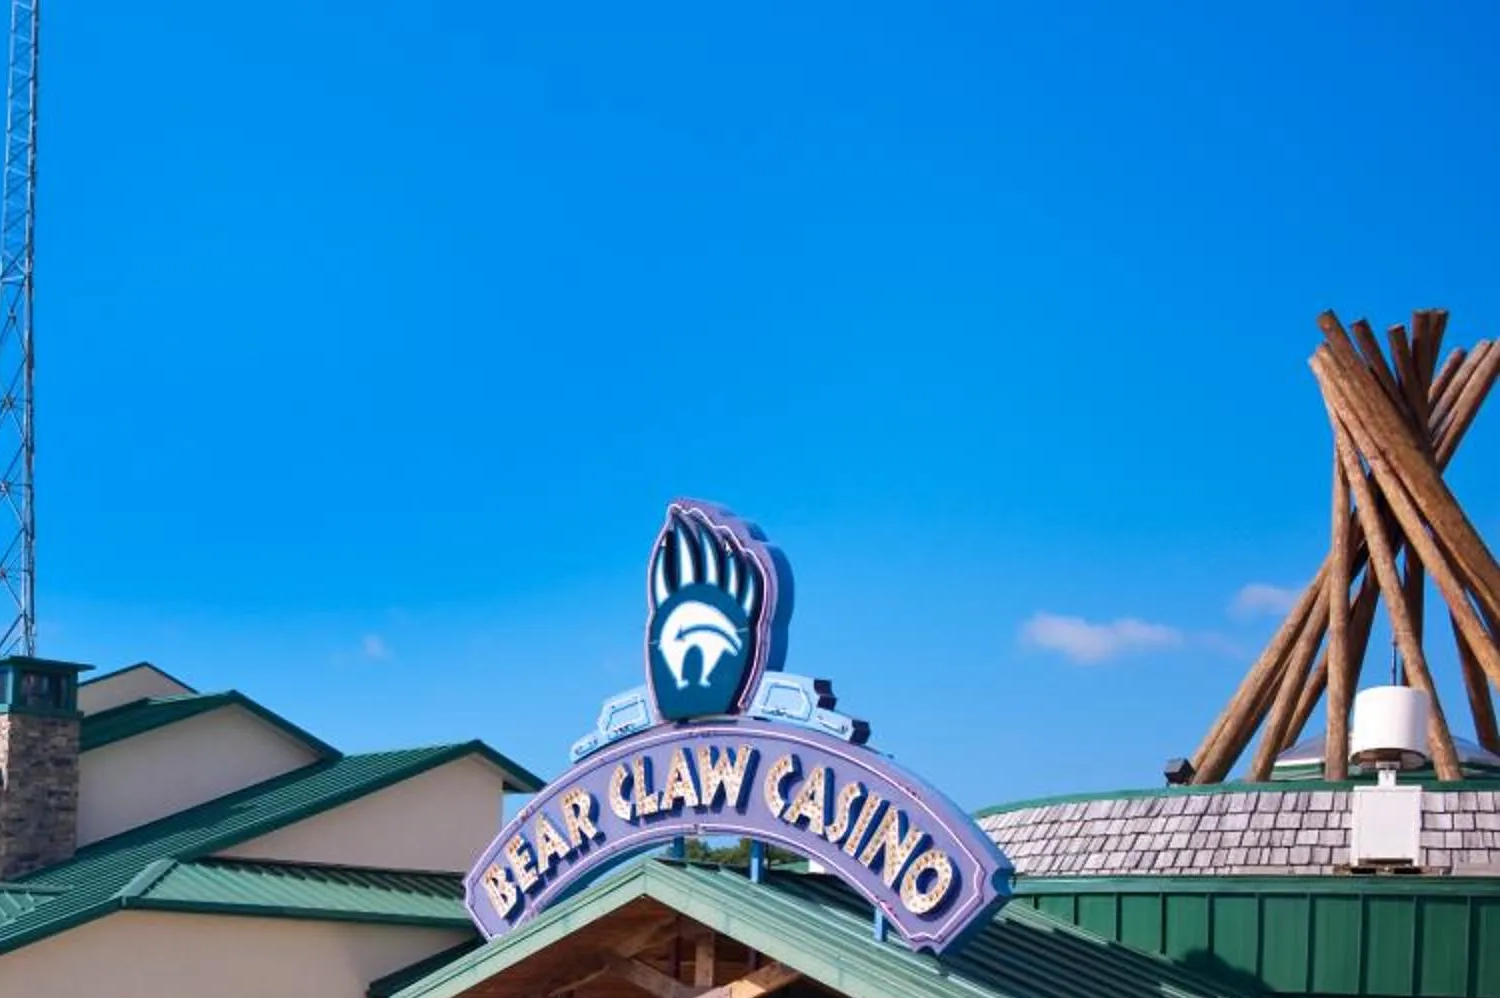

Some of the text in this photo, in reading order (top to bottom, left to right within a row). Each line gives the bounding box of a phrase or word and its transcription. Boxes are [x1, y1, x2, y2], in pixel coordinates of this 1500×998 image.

[482, 744, 956, 919] BEAR CLAW CASINO
